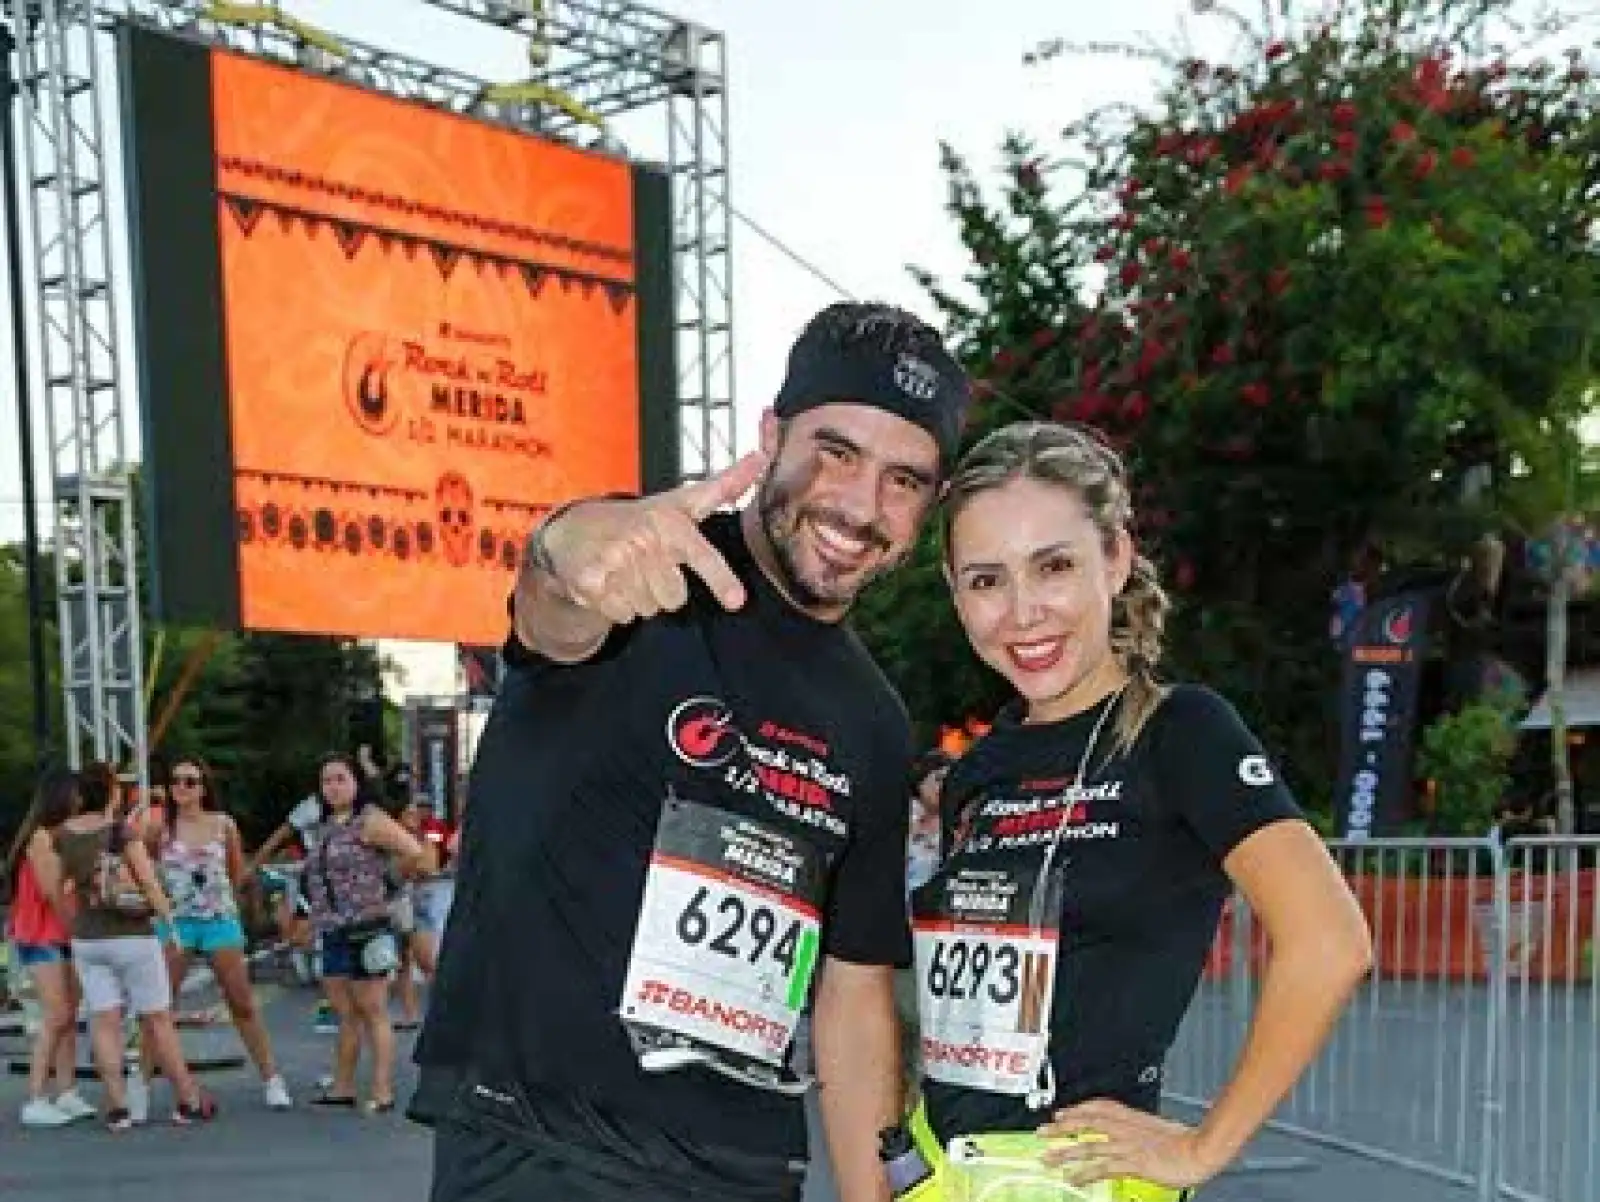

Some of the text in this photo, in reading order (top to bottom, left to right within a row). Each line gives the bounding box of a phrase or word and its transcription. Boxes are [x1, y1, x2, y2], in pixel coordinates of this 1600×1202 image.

[431, 382, 526, 425] MERIDA
[446, 425, 554, 458] MARATHON
[676, 886, 801, 978] 6294
[928, 939, 1019, 1004] 6293
